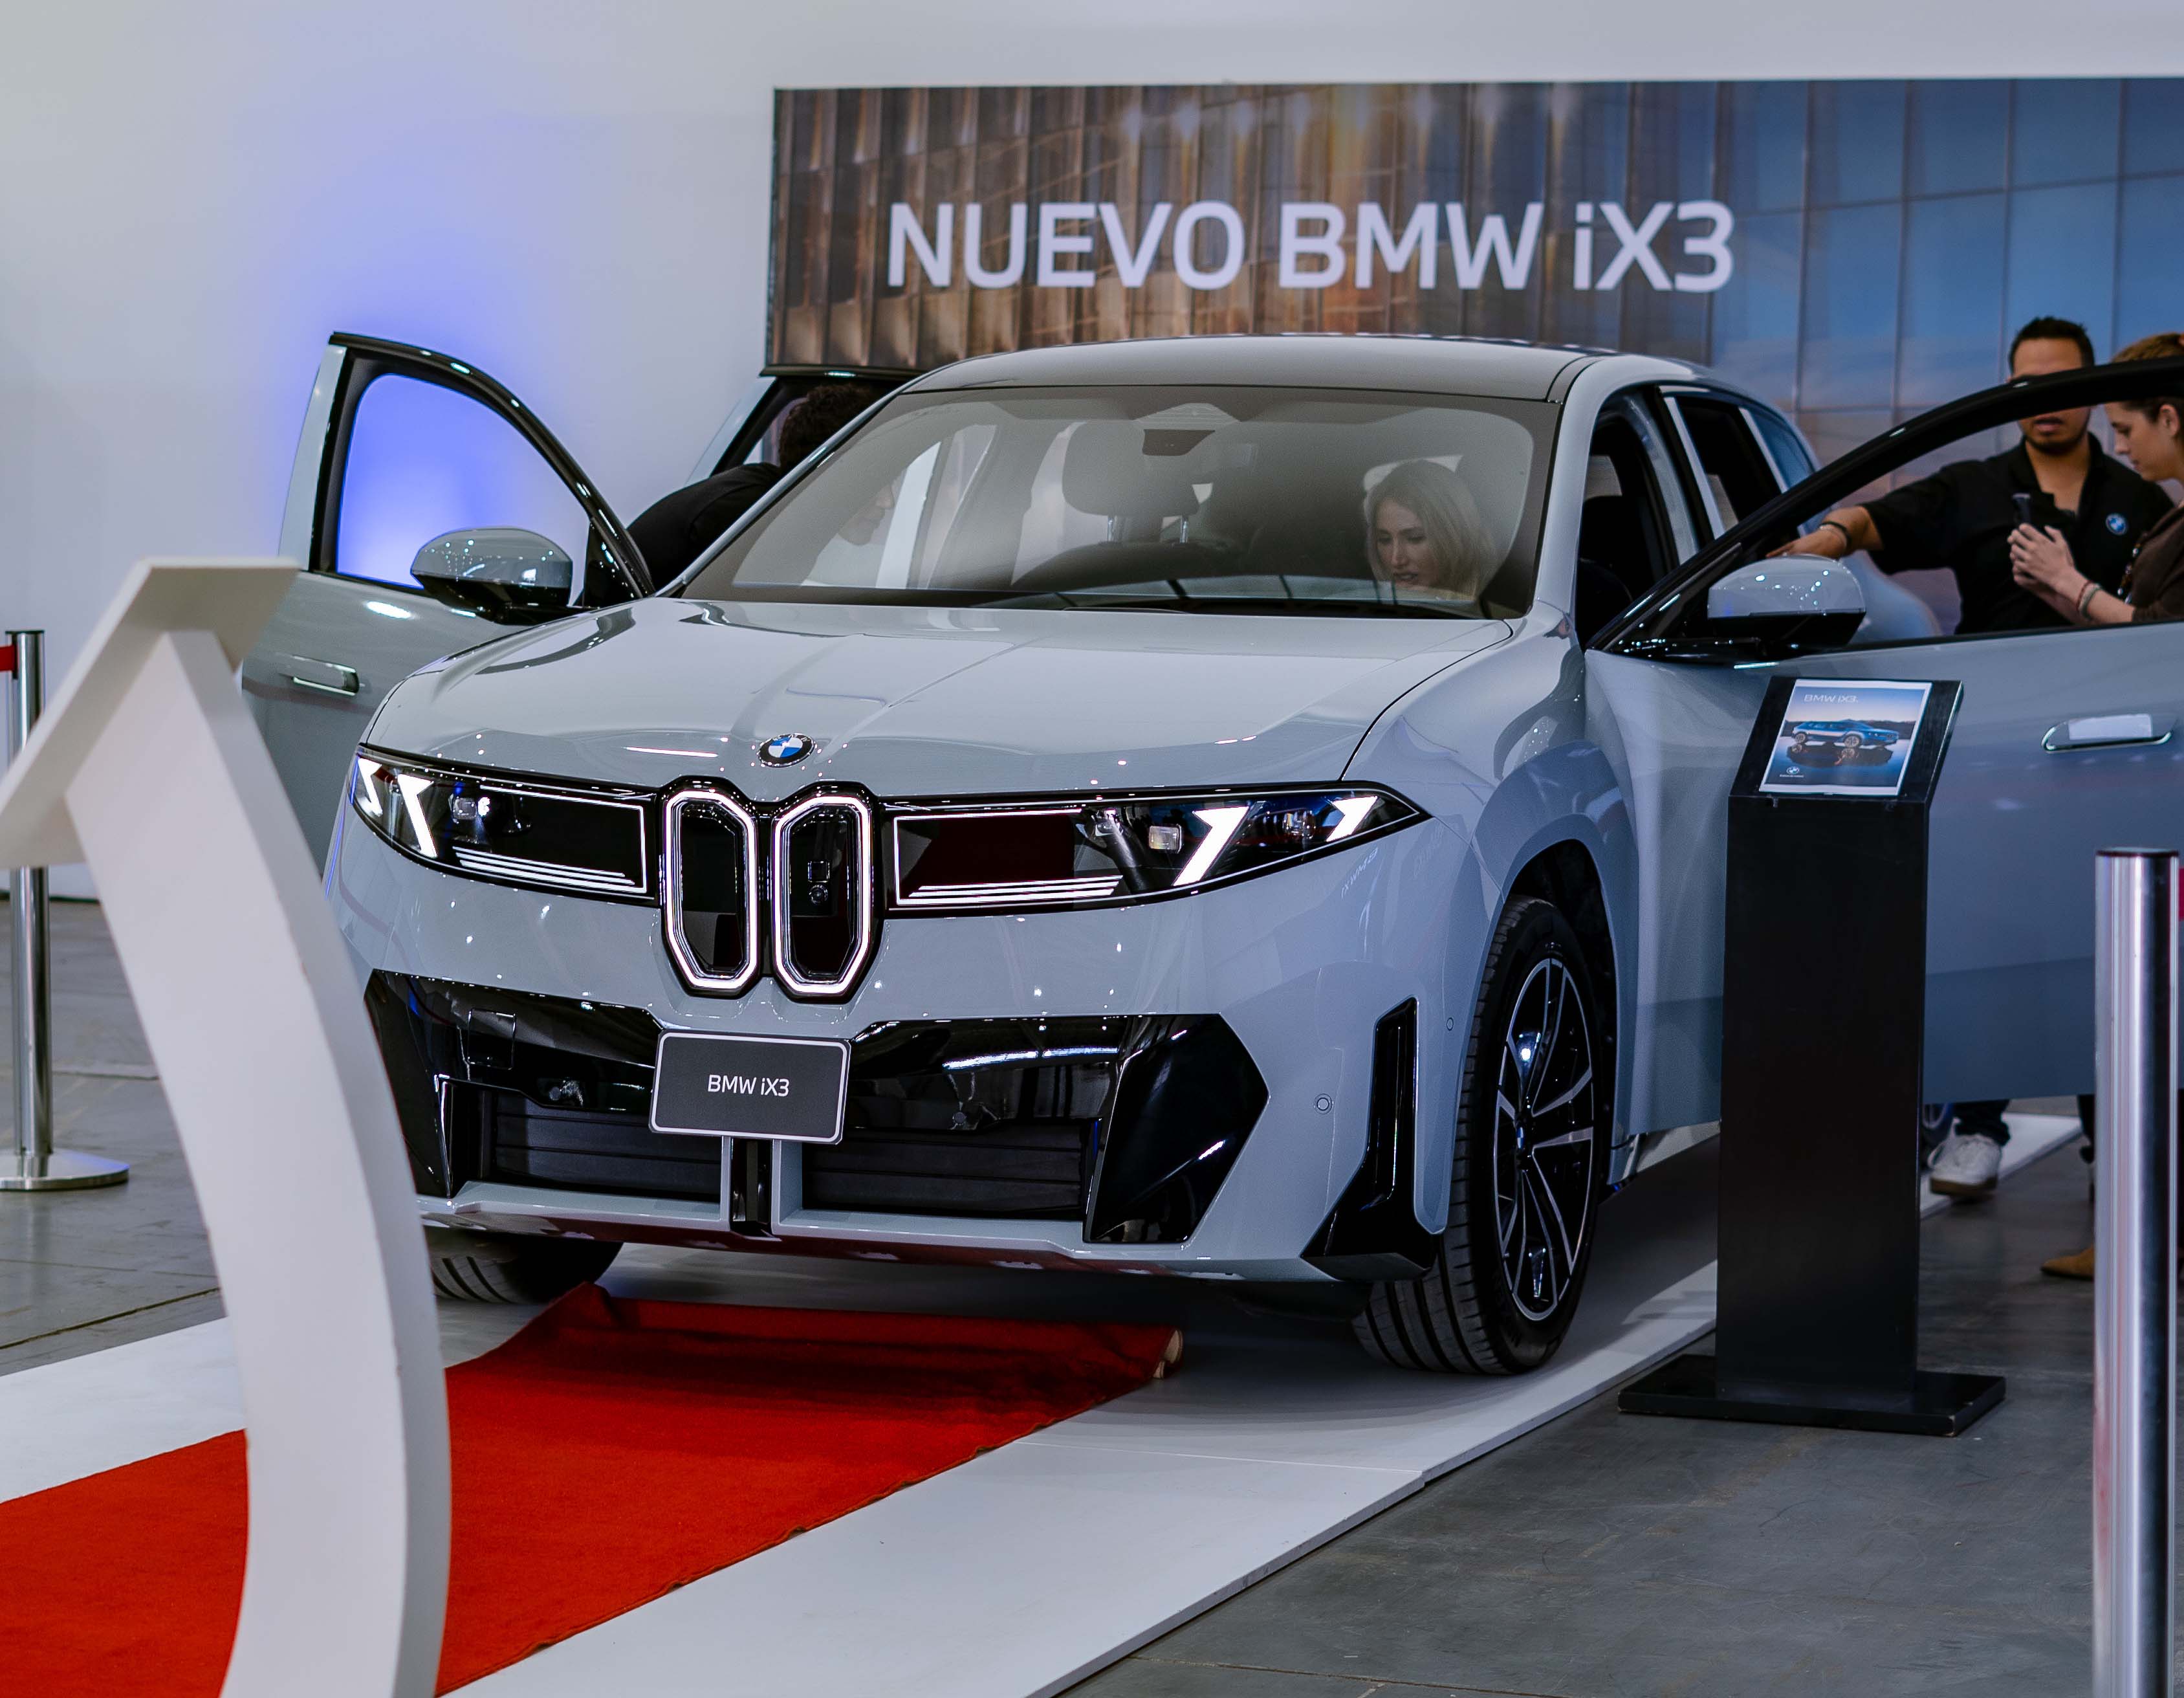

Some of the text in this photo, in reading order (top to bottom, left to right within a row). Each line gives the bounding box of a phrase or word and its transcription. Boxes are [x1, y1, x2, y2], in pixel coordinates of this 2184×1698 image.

[888, 203, 1732, 291] NUEVO BMW iX3
[1804, 694, 1836, 703] BMW
[707, 1074, 790, 1097] BMW iX3
